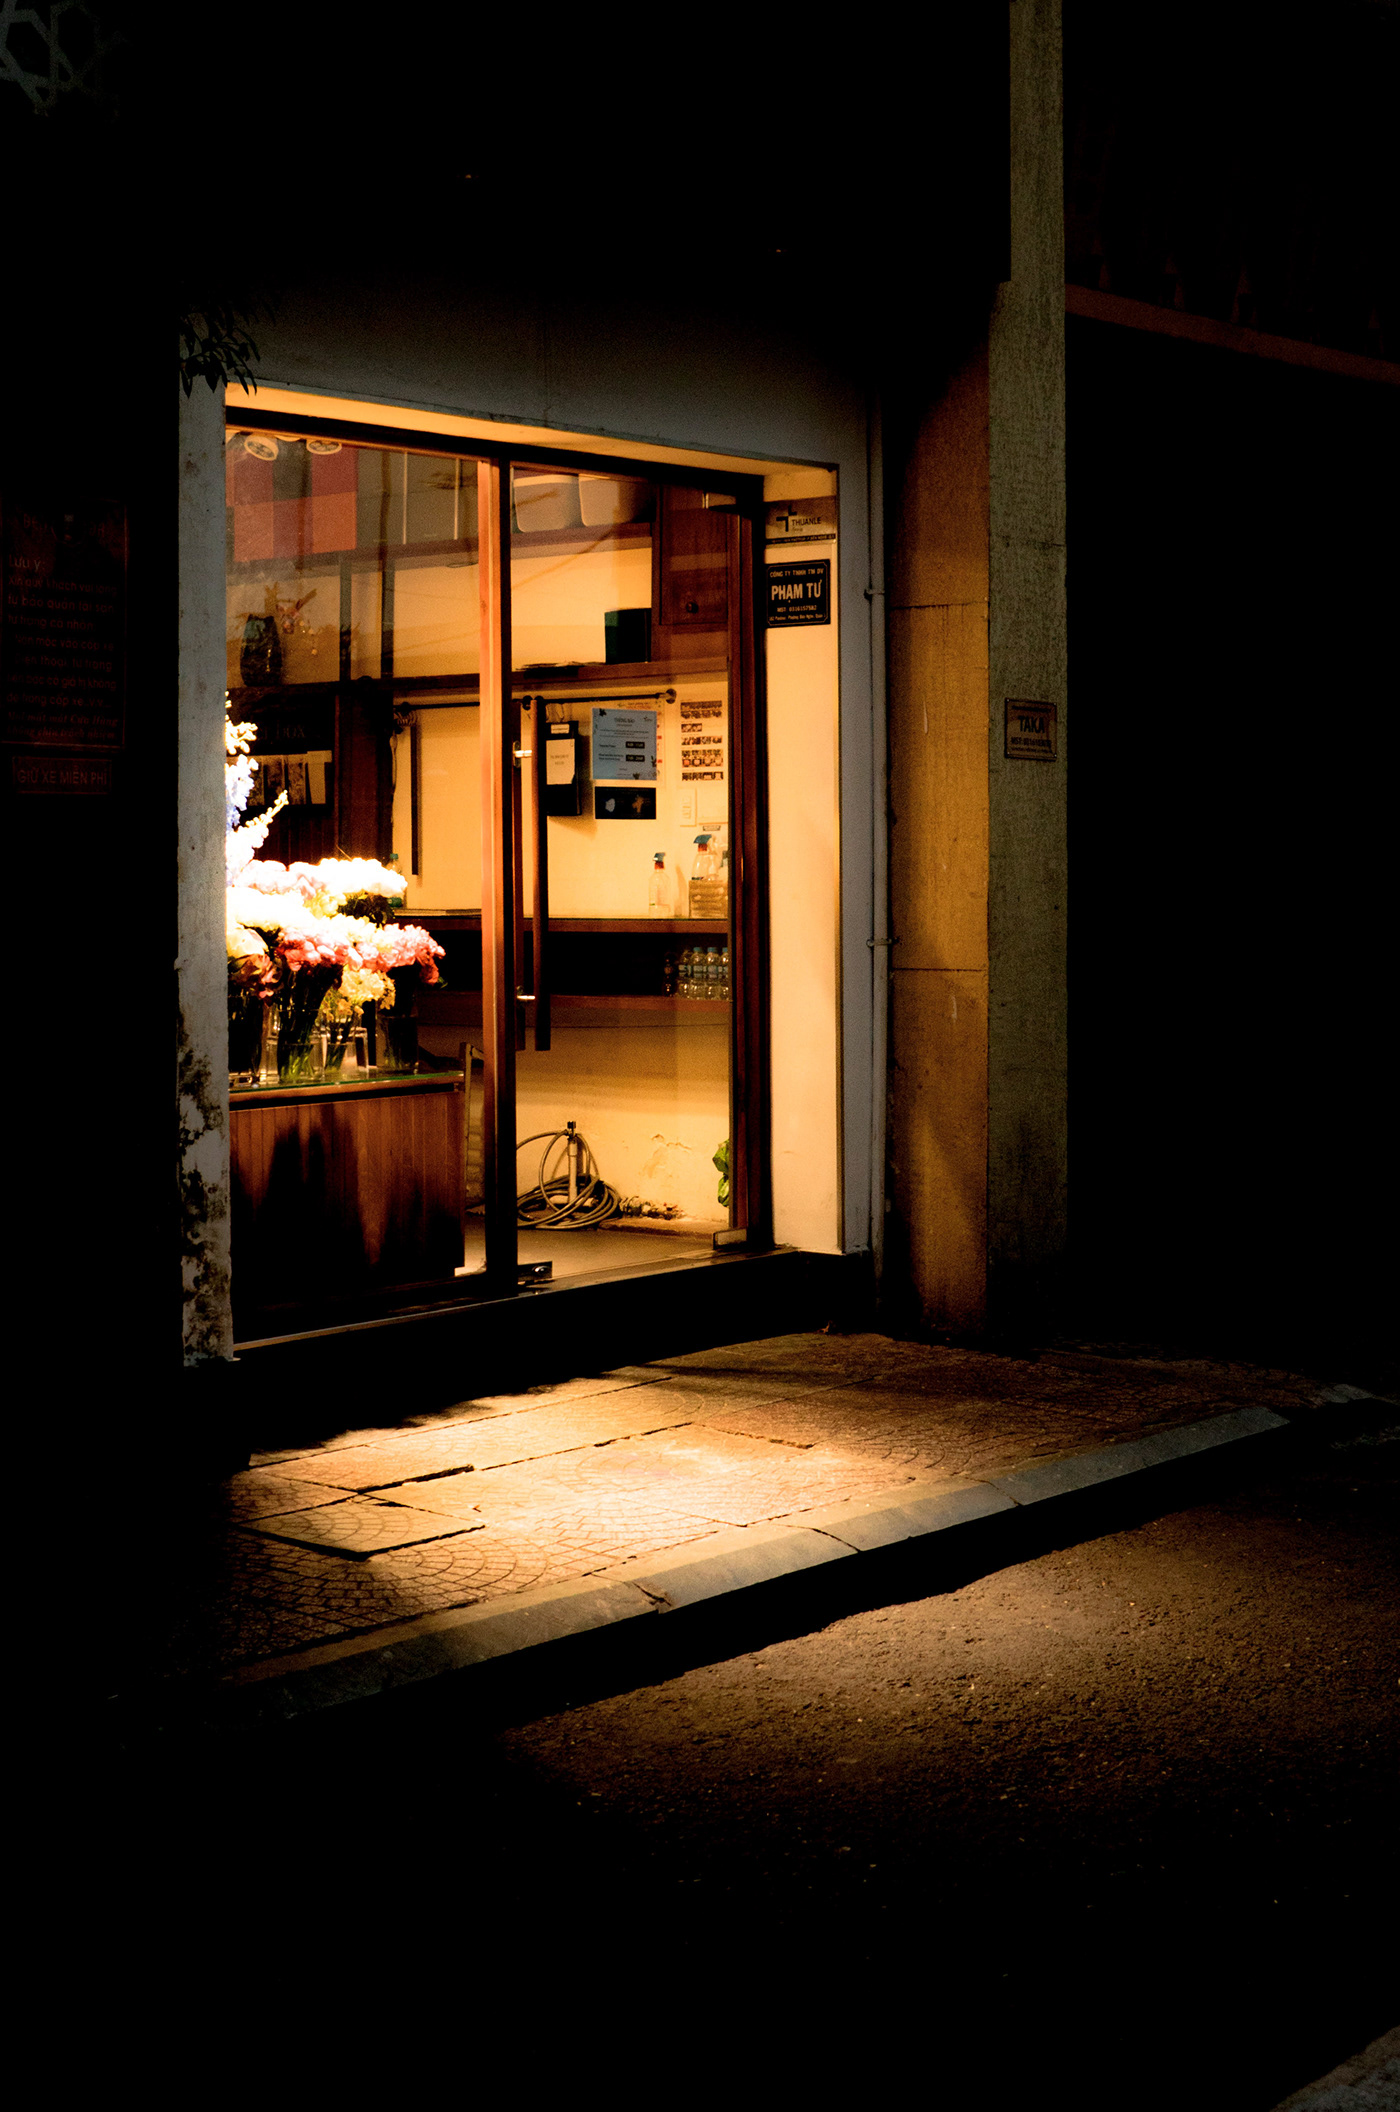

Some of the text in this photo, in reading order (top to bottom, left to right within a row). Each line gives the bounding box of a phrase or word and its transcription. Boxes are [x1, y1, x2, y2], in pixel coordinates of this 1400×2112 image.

[771, 579, 823, 603] PHẠM TƯ
[1017, 715, 1045, 734] TAKA
[17, 767, 39, 784] GIỮ
[41, 769, 57, 784] XE
